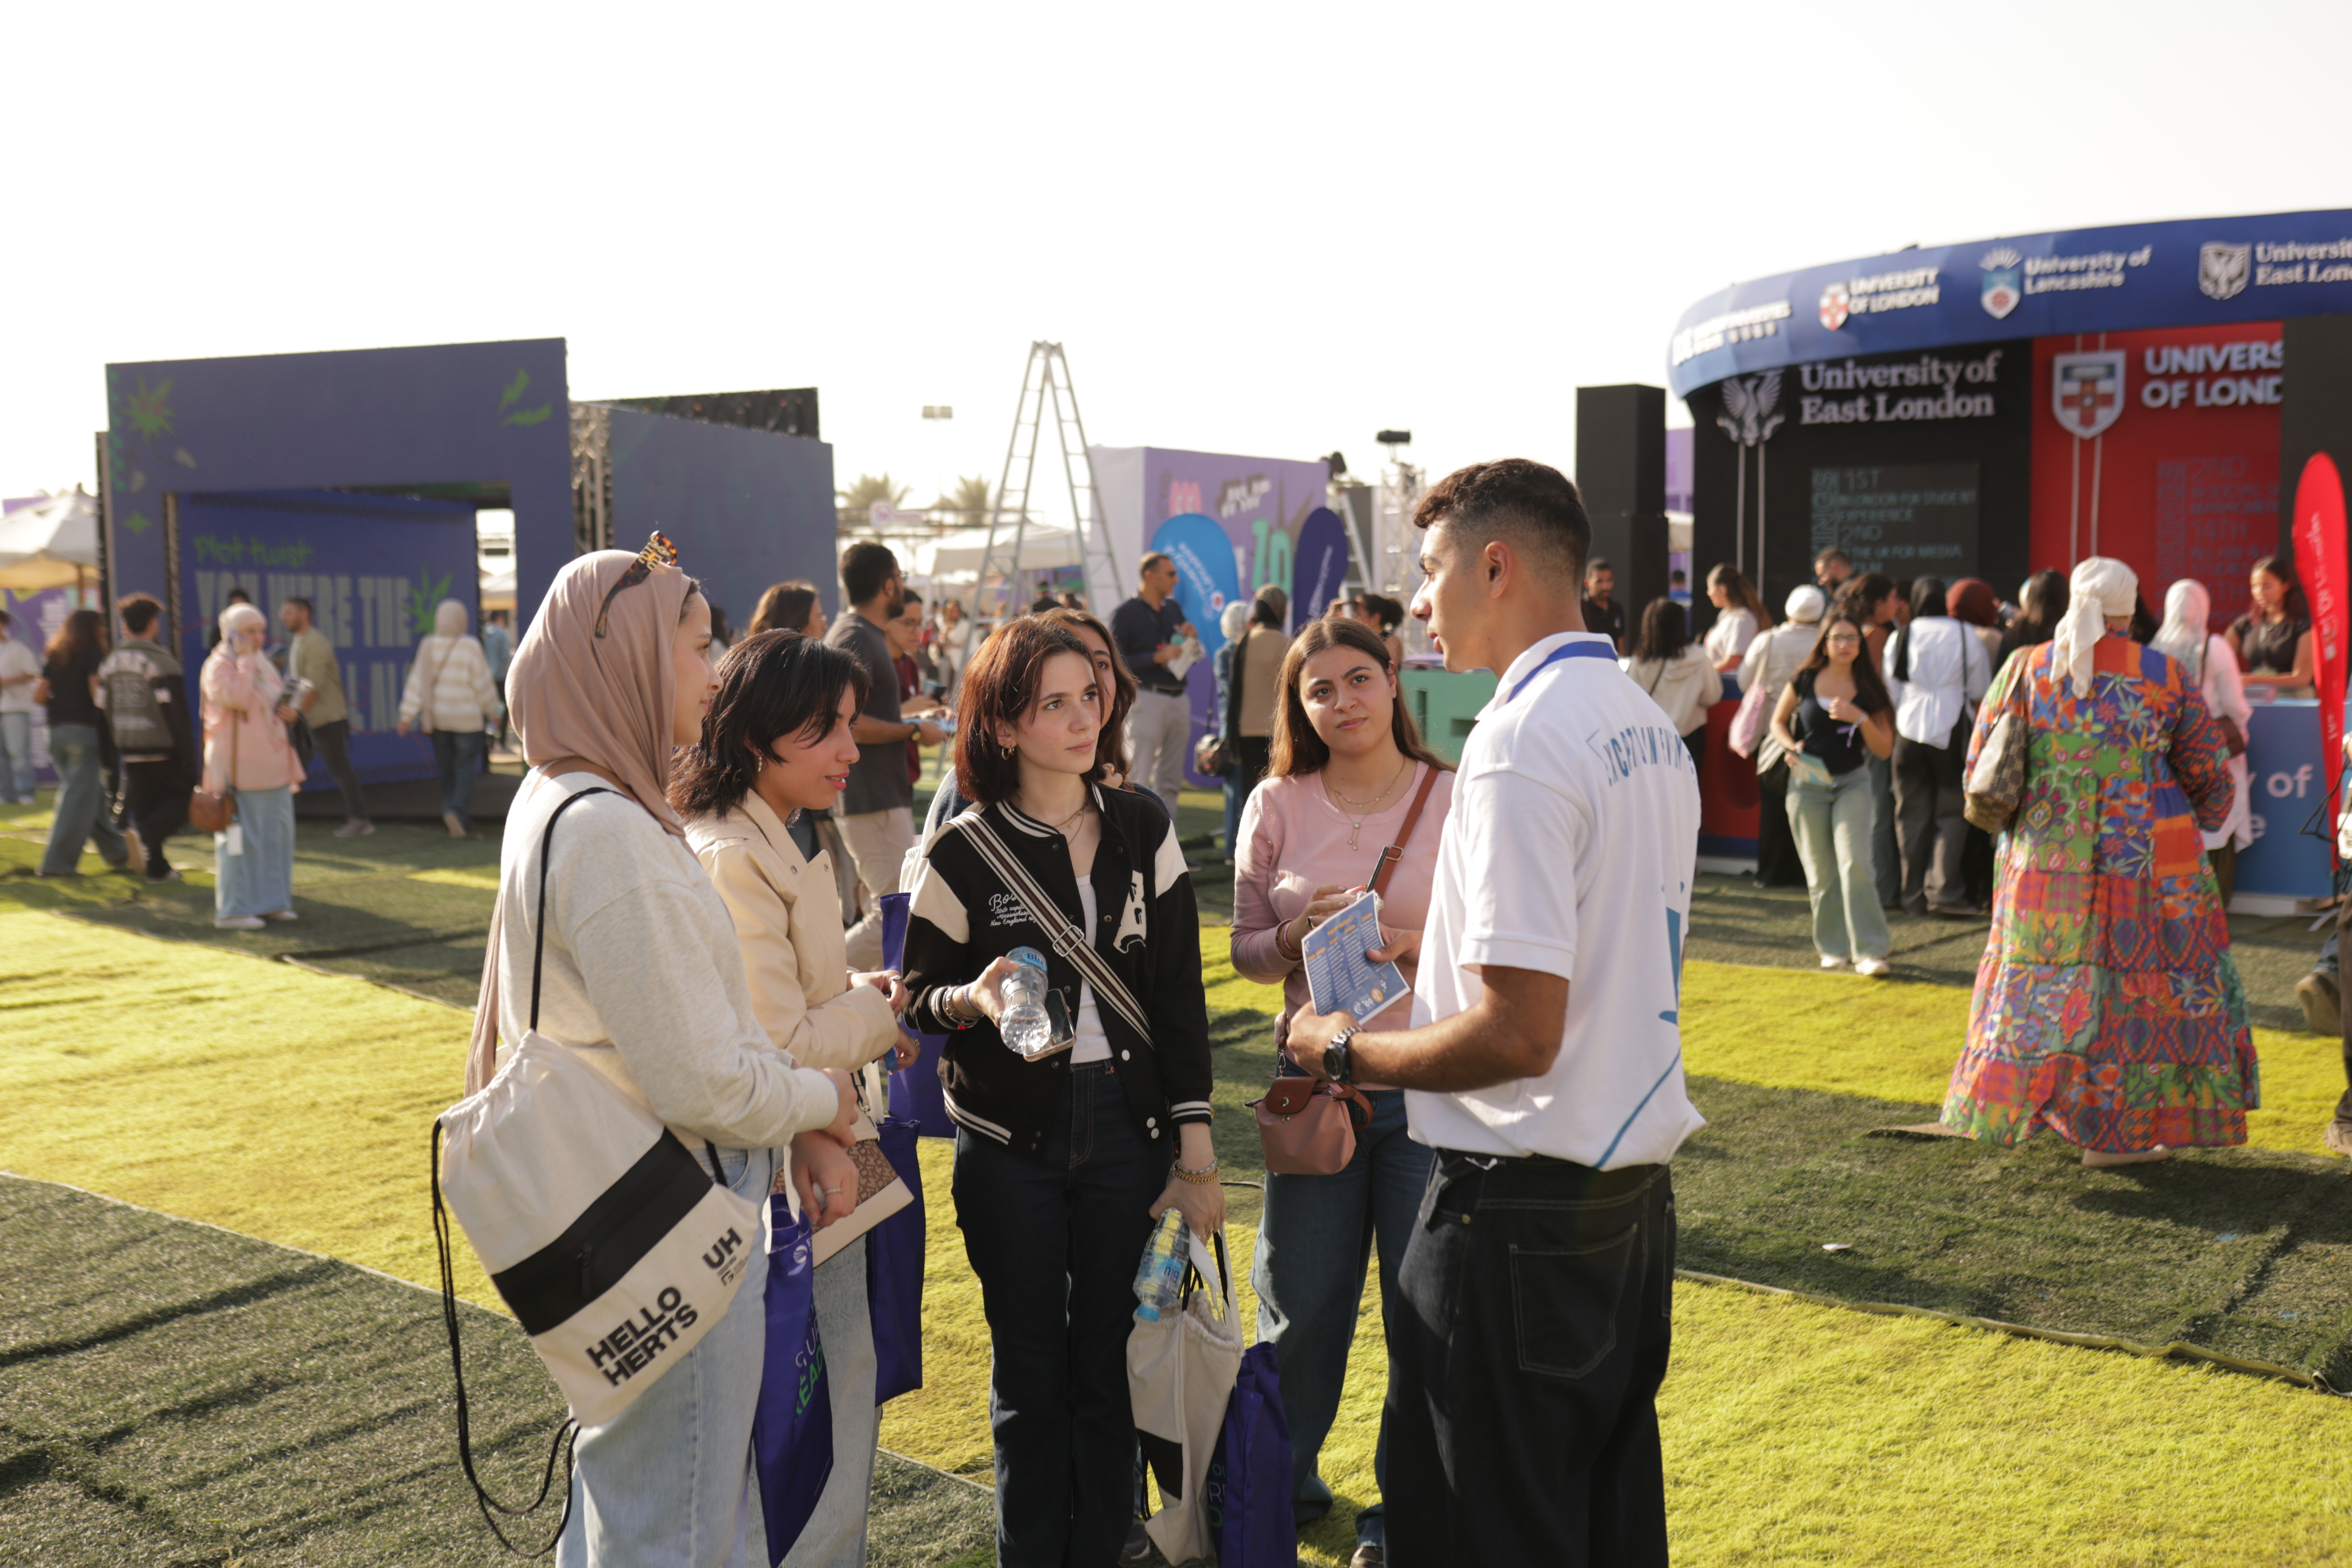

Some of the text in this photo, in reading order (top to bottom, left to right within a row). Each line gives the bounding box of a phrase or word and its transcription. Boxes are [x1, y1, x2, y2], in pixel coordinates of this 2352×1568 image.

[2024, 244, 2152, 277] University of
[2254, 261, 2307, 286] East
[1848, 265, 1940, 296] UNIVERSITY
[2023, 270, 2126, 295] Lancashire
[1848, 285, 1940, 315] OF LONDON
[1800, 349, 2003, 391] University of
[1800, 386, 1996, 425] East London
[2141, 378, 2189, 409] OF
[1844, 467, 1883, 491] 1ST
[1923, 489, 1977, 506] STUDENT
[2189, 518, 2249, 544] 14TH
[1917, 543, 1964, 559] MEDIA
[358, 576, 412, 648] THE
[2266, 763, 2314, 799] of
[1003, 915, 1027, 926] England
[1027, 953, 1043, 966] Blu
[701, 1226, 743, 1269] UH
[1163, 1265, 1180, 1284] Blu
[585, 1286, 682, 1370] HELLO
[601, 1303, 698, 1388] HERTS
